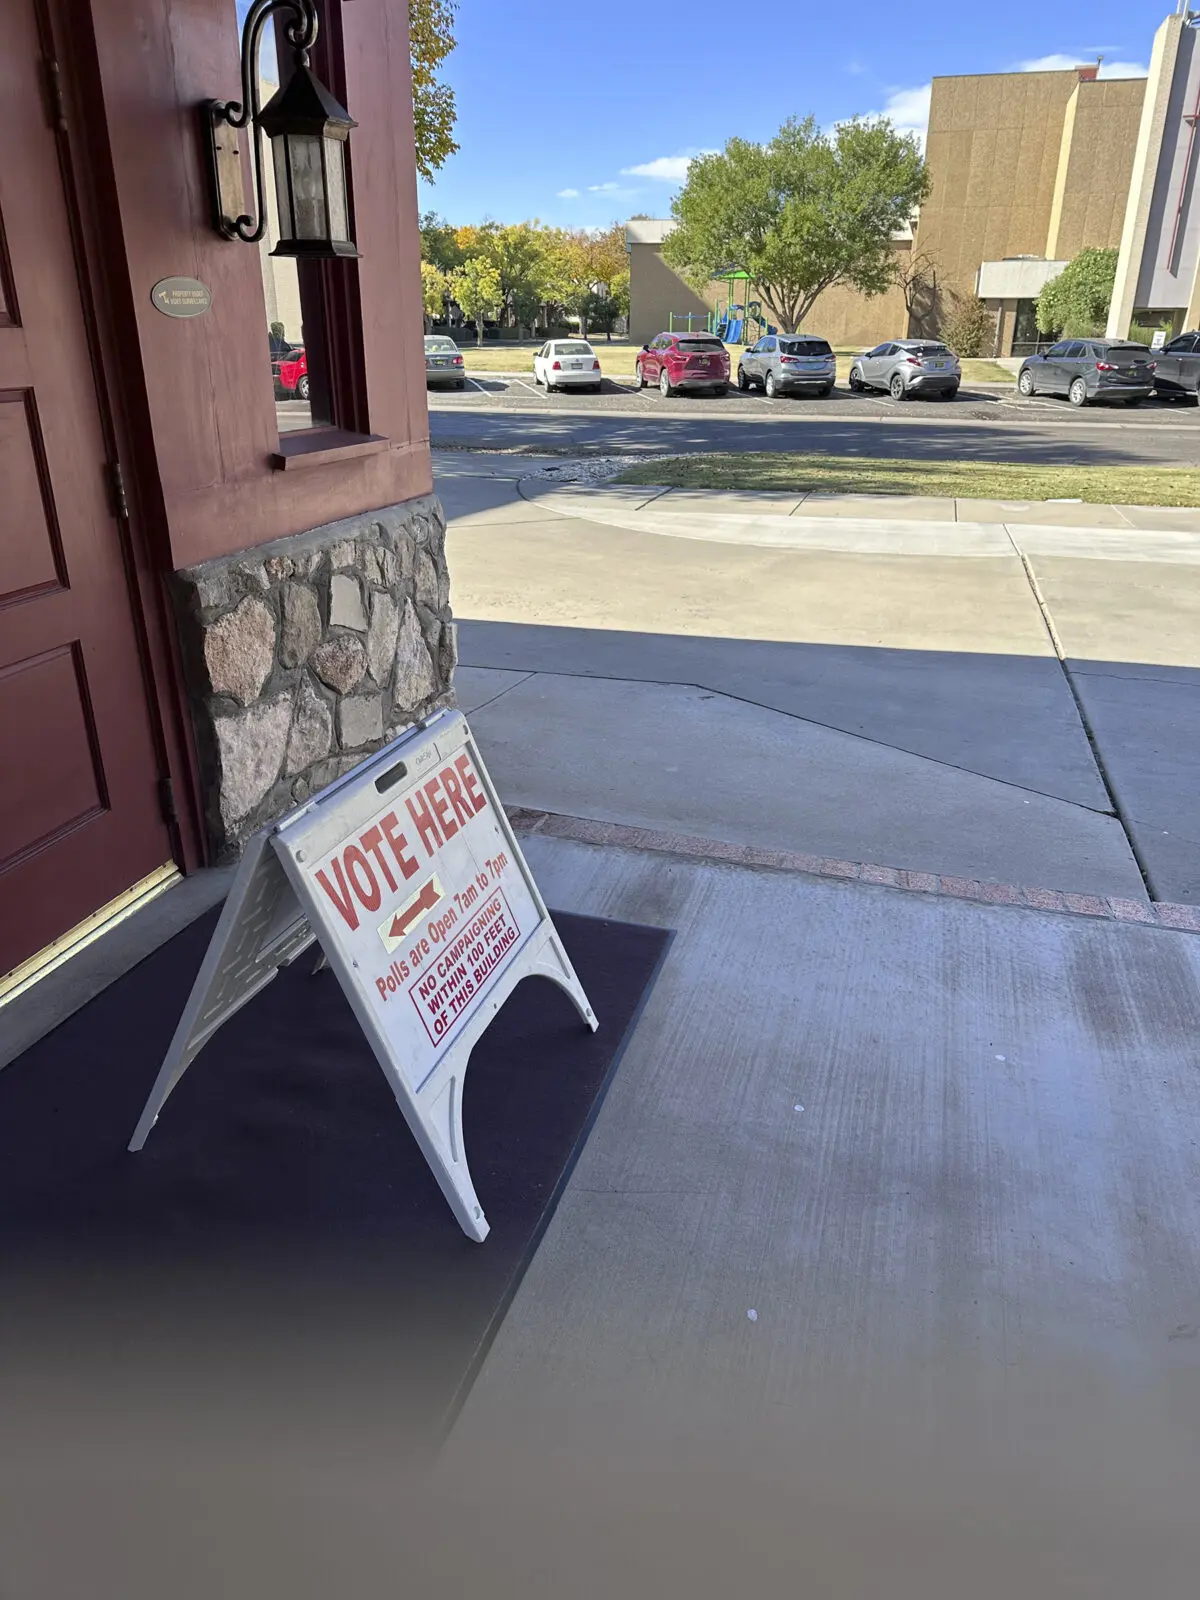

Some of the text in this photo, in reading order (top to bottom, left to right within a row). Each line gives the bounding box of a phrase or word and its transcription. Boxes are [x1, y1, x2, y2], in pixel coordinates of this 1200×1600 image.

[314, 753, 487, 932] VOTE HERE
[375, 851, 509, 1001] Polls are Open 7am to 7pm
[418, 898, 502, 1001] NO CAMPAIGNING
[427, 913, 507, 1015] WITHIN 100 FEET
[434, 926, 515, 1035] OF THIS BUILDING
